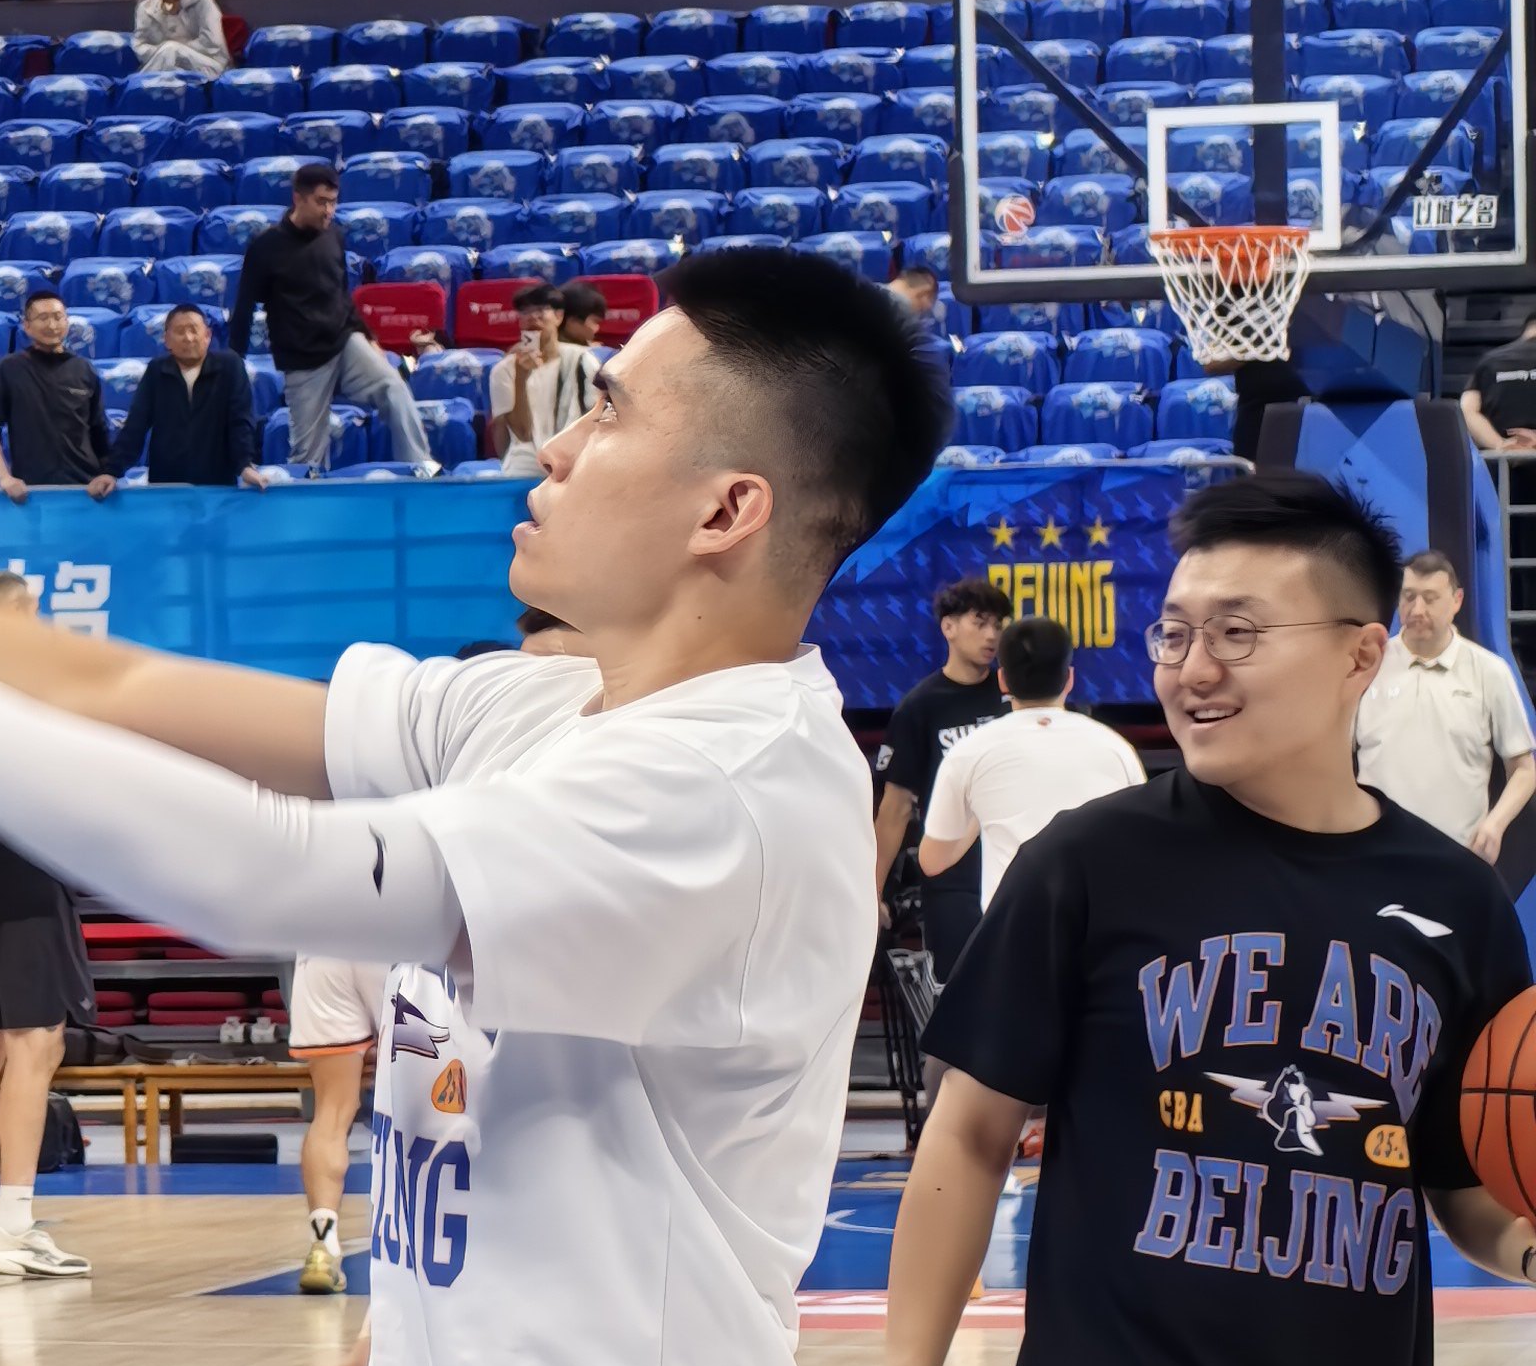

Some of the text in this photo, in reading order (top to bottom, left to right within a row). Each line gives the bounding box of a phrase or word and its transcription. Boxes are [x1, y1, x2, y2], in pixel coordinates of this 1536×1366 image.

[1138, 931, 1443, 1124] WE ARE
[1159, 1090, 1204, 1133] CBA
[1134, 1149, 1417, 1295] BEIJING
